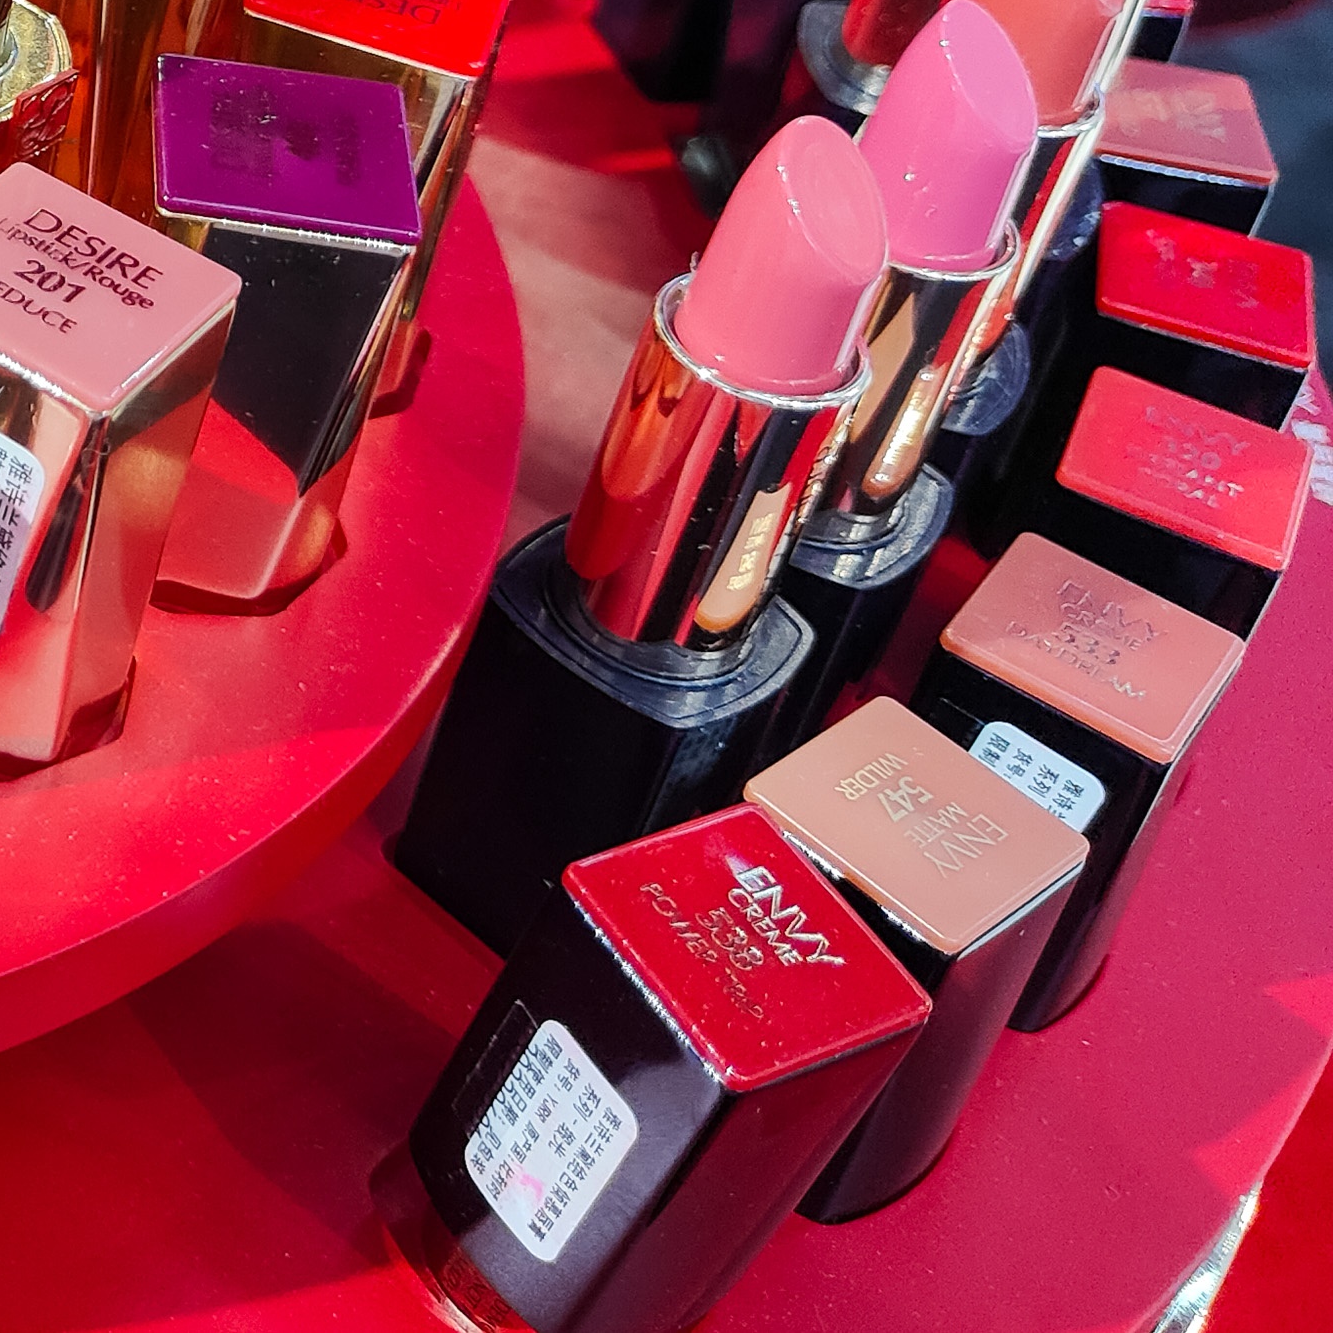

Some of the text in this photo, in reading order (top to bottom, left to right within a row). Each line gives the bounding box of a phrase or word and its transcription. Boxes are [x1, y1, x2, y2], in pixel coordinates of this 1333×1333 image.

[13, 258, 88, 303] 201
[22, 207, 164, 291] DESIRE
[834, 752, 910, 802] WILDER
[875, 775, 935, 824] 547
[902, 801, 969, 849] MATTE
[923, 813, 1009, 880] ENVY
[638, 881, 719, 965] POWER
[695, 905, 766, 972] 538
[727, 887, 804, 967] CREME
[735, 865, 847, 967] ENVY
